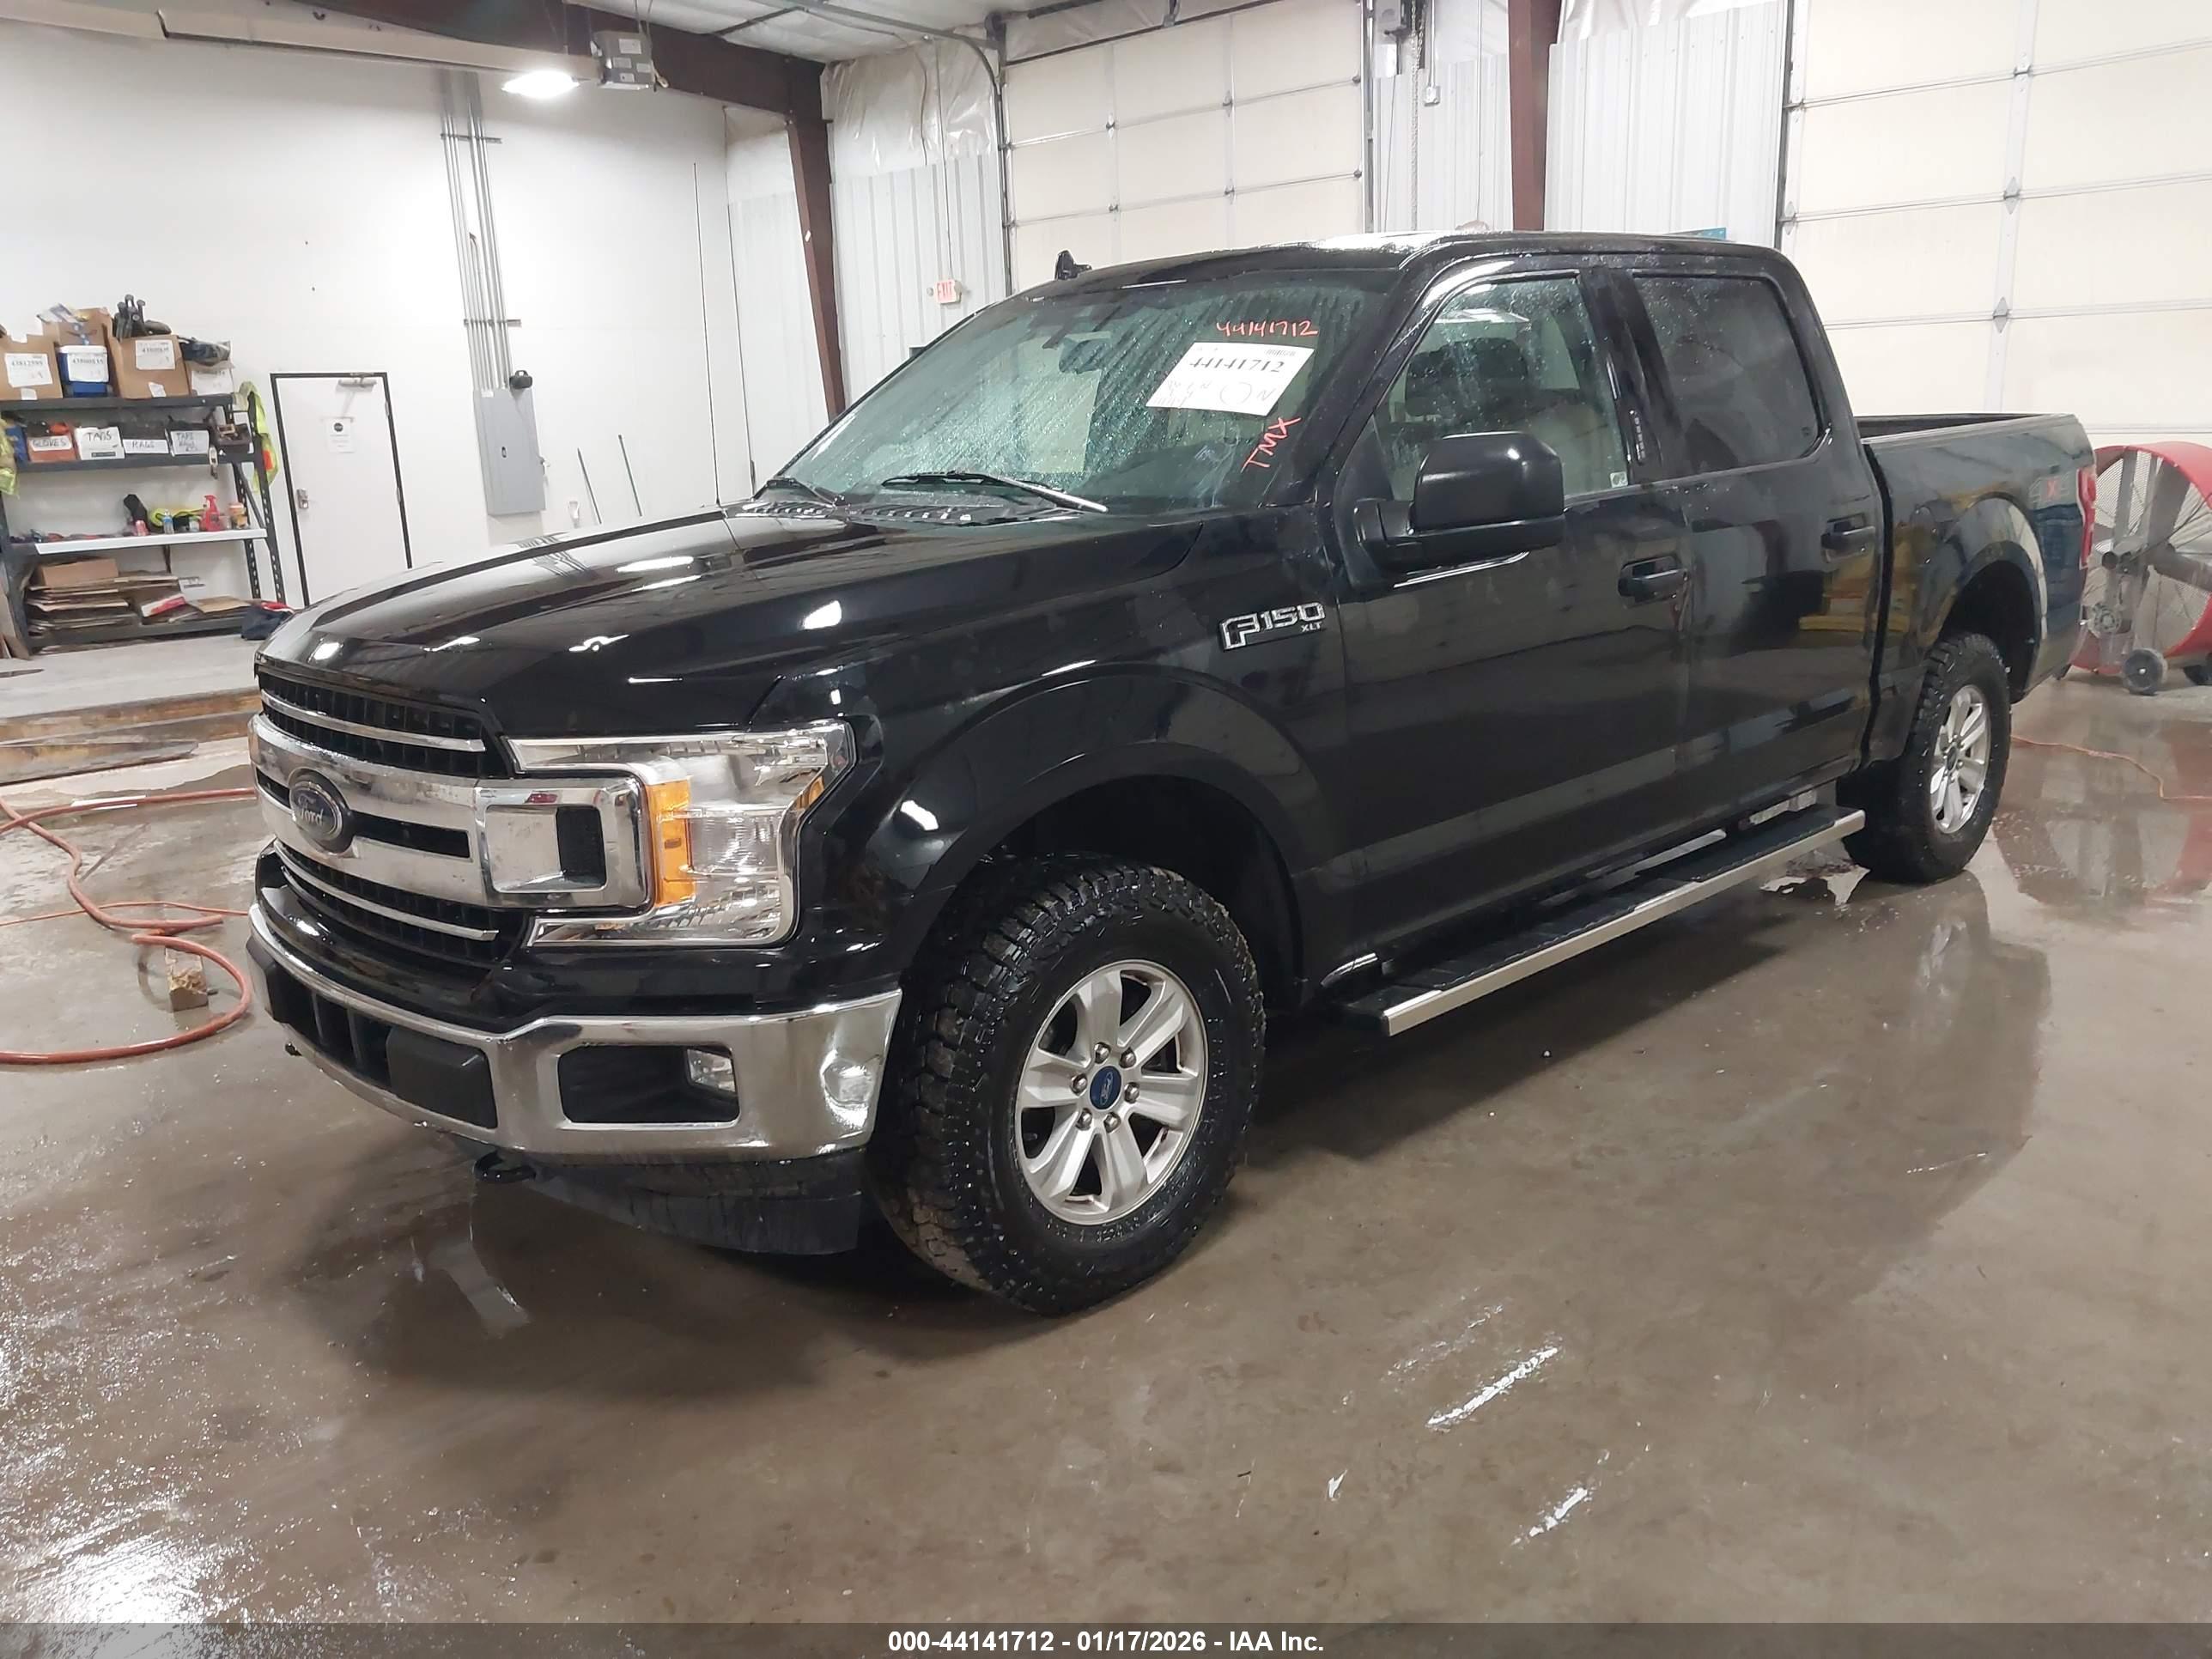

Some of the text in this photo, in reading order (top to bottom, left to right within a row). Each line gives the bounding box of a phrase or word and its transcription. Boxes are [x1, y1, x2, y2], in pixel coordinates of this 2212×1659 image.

[937, 281, 952, 297] EXIT
[1216, 320, 1319, 337] 44141712
[1189, 356, 1285, 374] 44141712
[33, 437, 67, 448] GLOVES
[1241, 416, 1302, 474] TMX
[1220, 601, 1326, 651] F150
[1301, 621, 1322, 633] XLT
[297, 793, 324, 826] Ford
